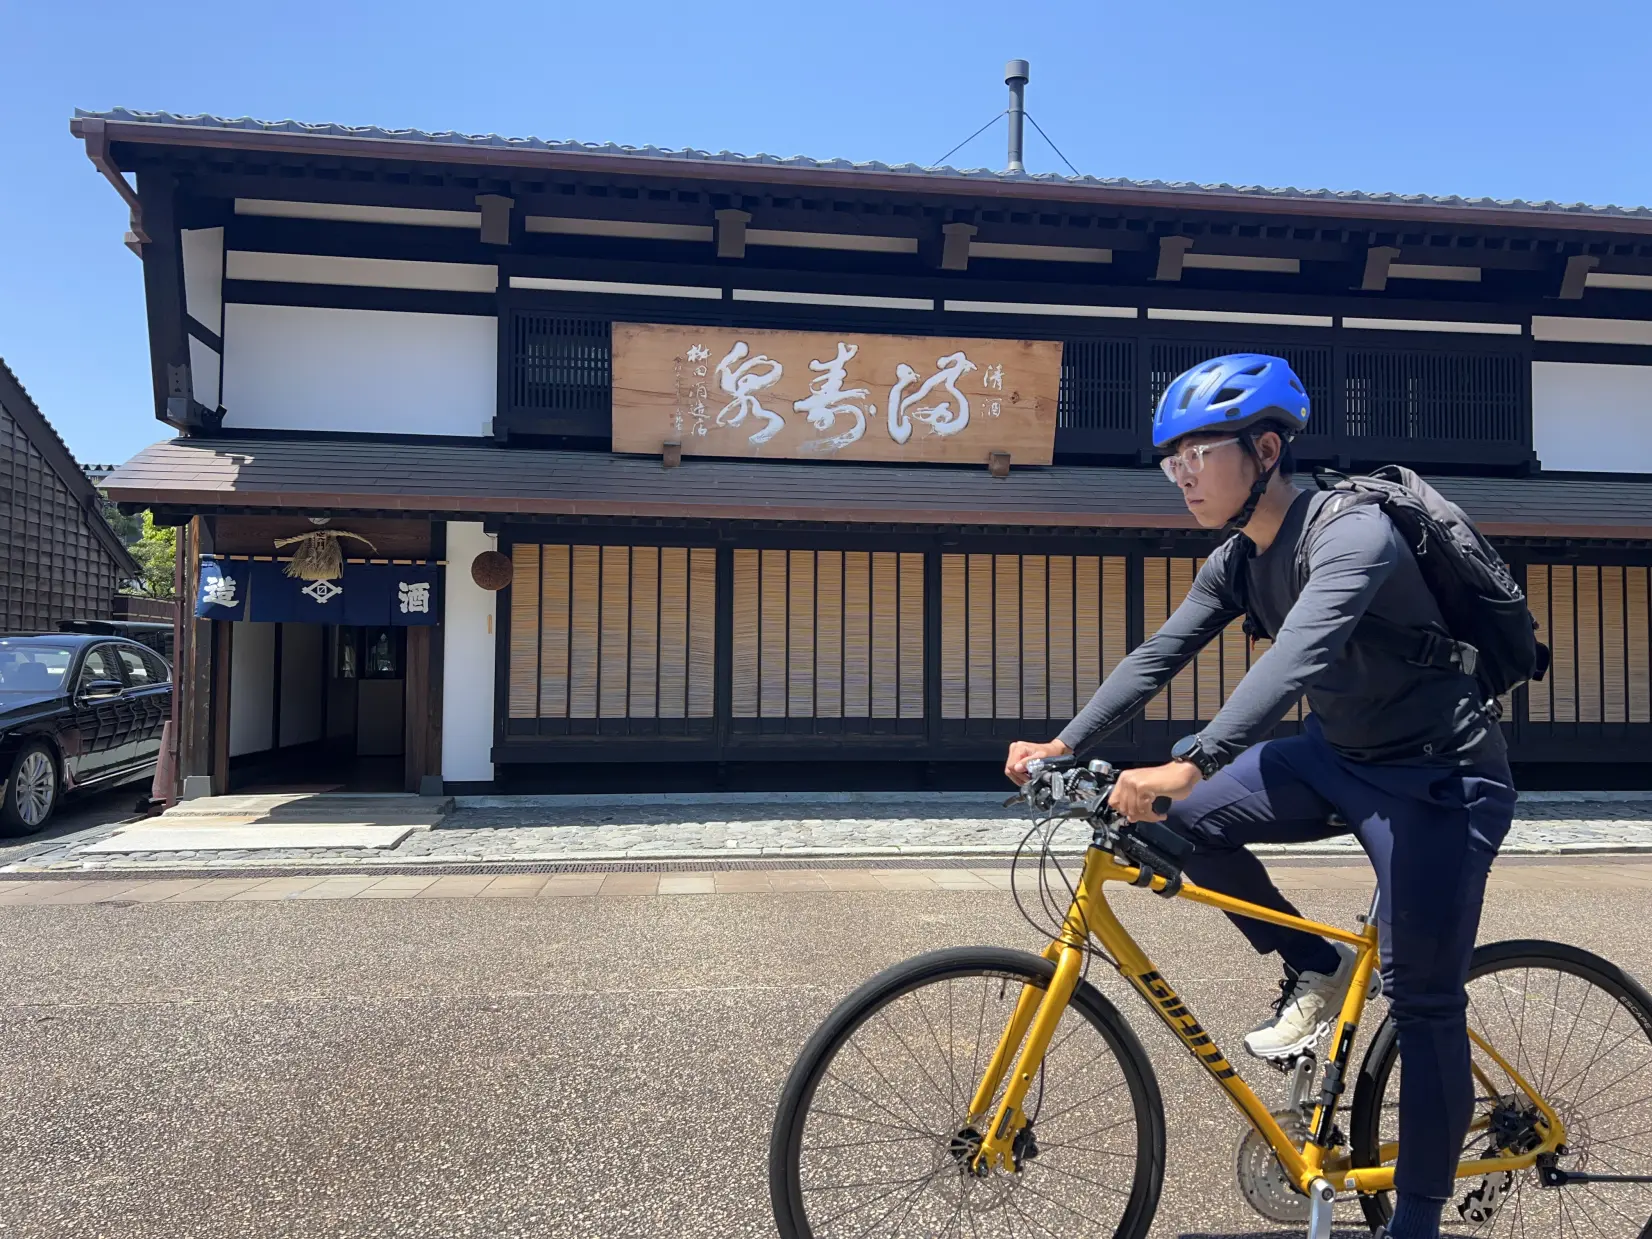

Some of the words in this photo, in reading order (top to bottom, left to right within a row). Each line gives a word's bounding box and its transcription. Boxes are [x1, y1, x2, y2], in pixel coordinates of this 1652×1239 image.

[203, 576, 239, 607] 造
[398, 581, 430, 613] 酒
[1139, 971, 1236, 1079] GIANT
[1619, 996, 1651, 1029] ESCAPE
